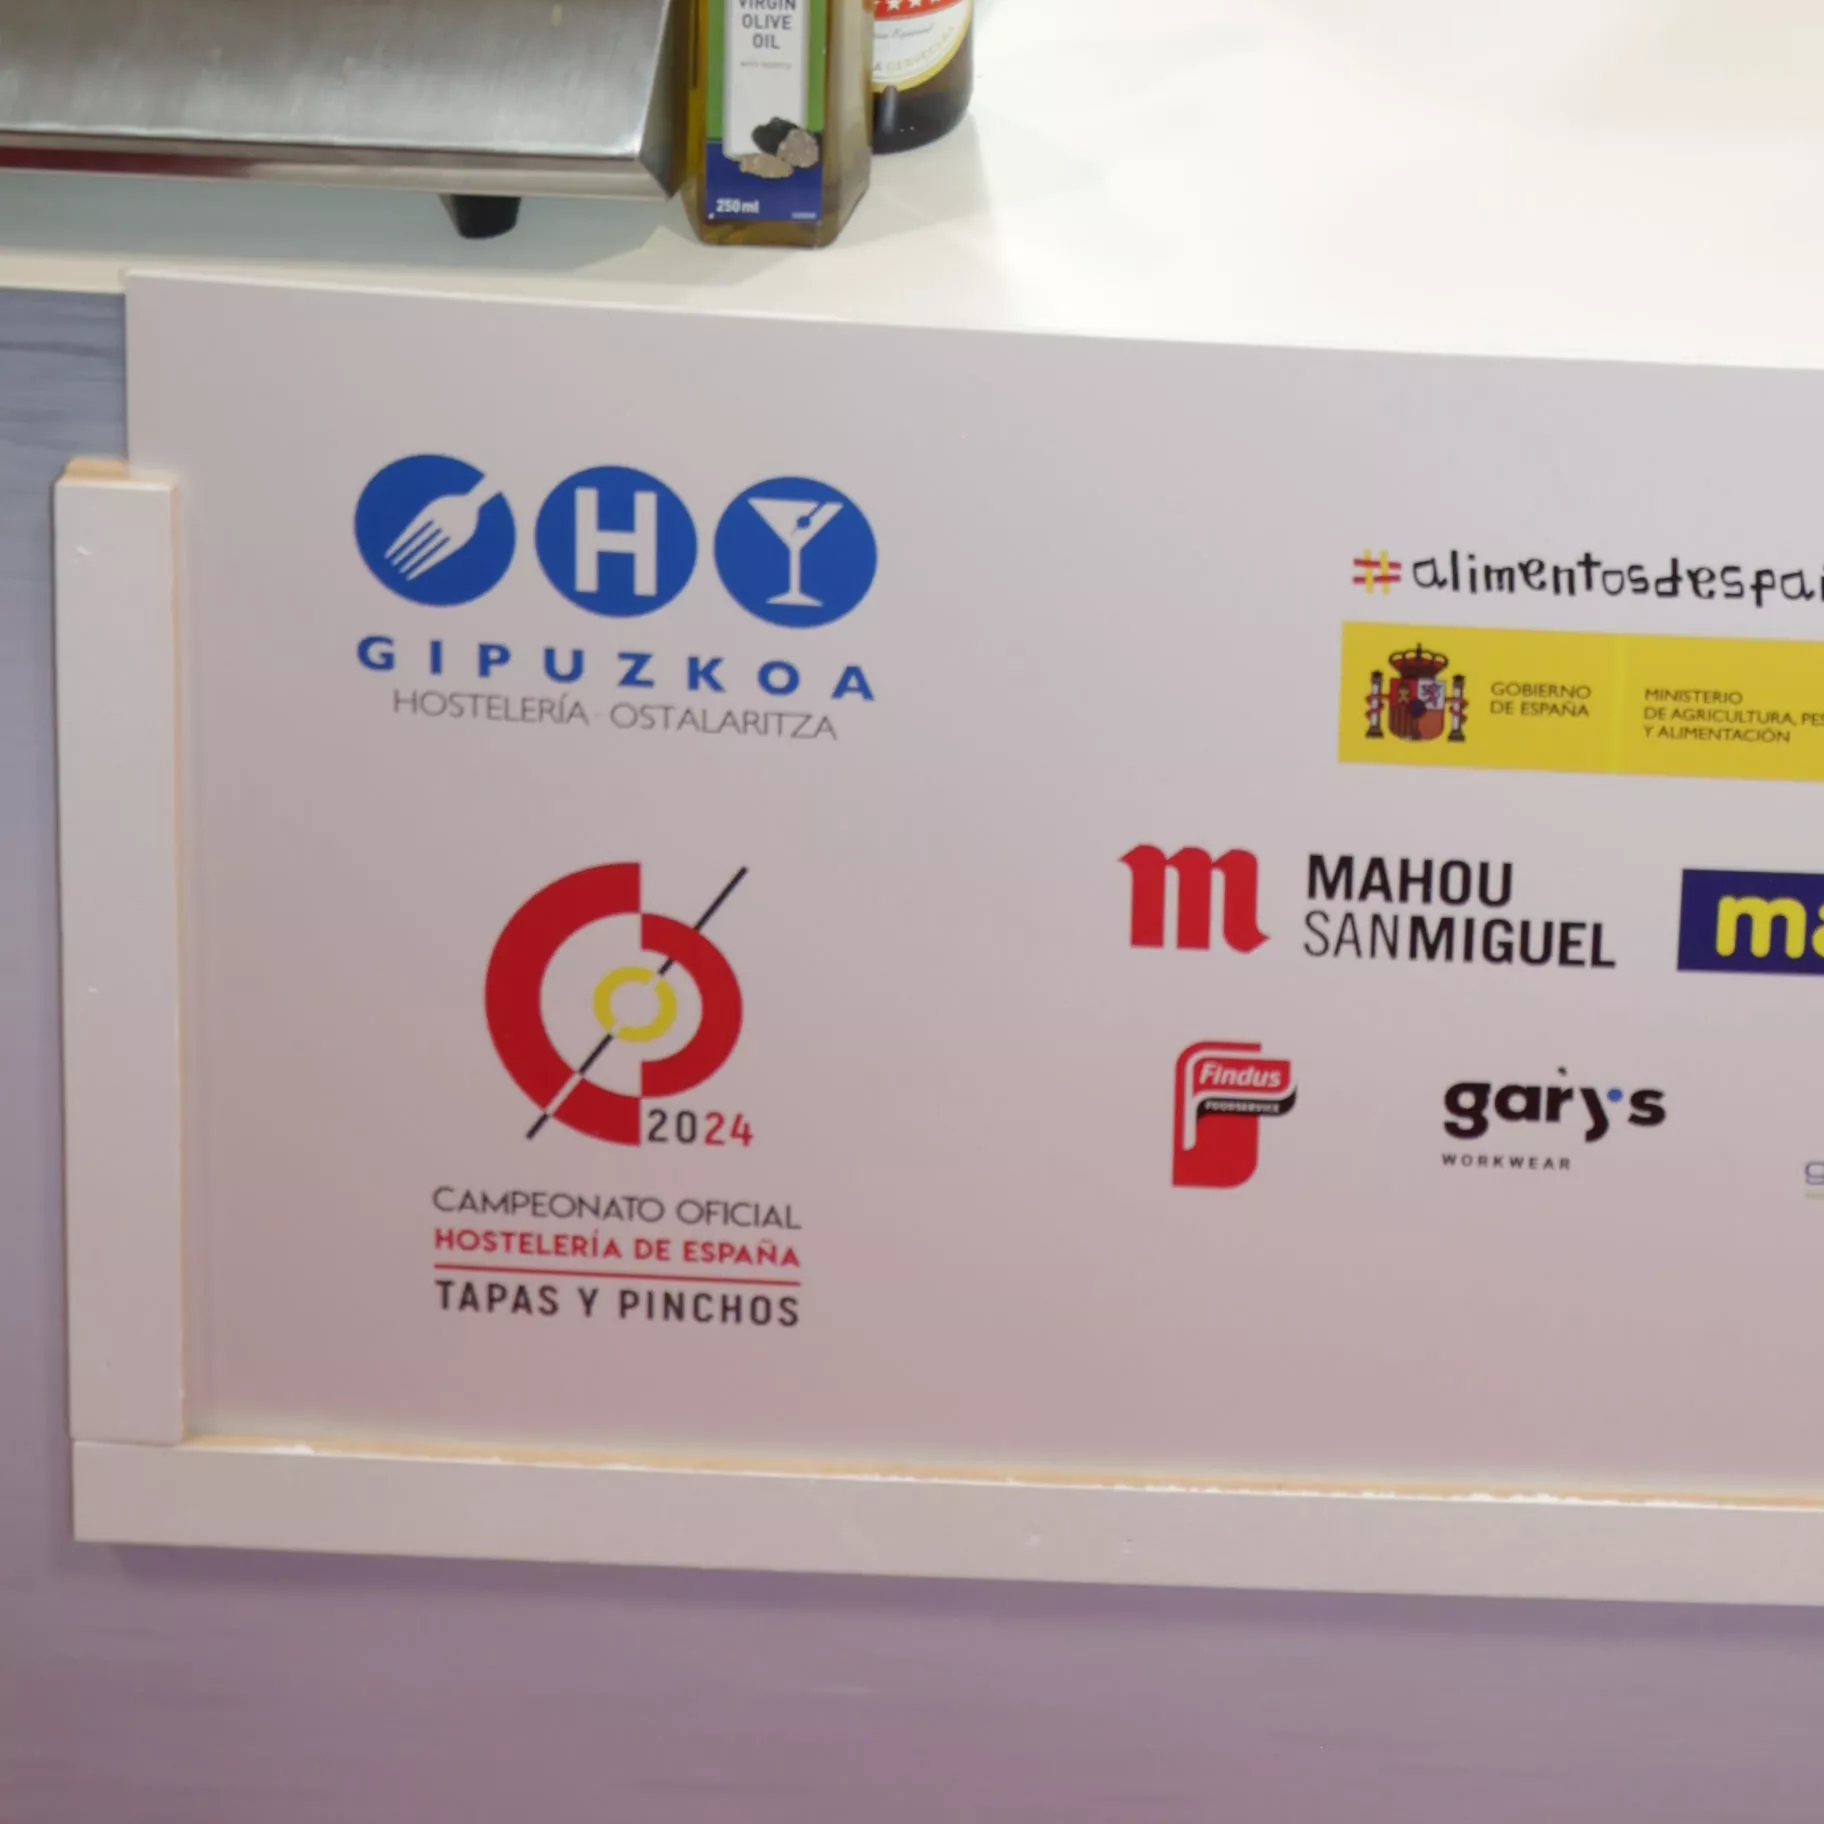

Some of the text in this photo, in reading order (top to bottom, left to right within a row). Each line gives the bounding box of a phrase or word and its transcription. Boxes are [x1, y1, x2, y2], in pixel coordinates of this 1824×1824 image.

[742, 14, 792, 30] OLIVE
[752, 34, 780, 50] OIL
[716, 198, 760, 214] 250 ml
[356, 635, 876, 702] GIPUZKOA
[1491, 681, 1592, 701] GOBIERNO
[1644, 688, 1743, 706] MINISTERIO
[393, 689, 838, 741] HOSTELERÍA OSTALARITZA
[1490, 699, 1590, 718] DE ESPAÑA
[1643, 706, 1667, 721] DE
[1643, 725, 1791, 744] Y ALIMENTACIÓN
[1307, 854, 1513, 908] MAHOU
[1304, 910, 1616, 968] SANMIGUEL
[1199, 1060, 1281, 1088] Findus
[648, 1109, 754, 1147] 2024
[1441, 1153, 1571, 1170] WORKWEAR
[432, 1186, 803, 1230] CAMPEONATO OFICIAL
[434, 1228, 800, 1268] HOSTELERÍA DE ESPAÑA
[434, 1280, 800, 1327] TAPAS Y PINCHOS
